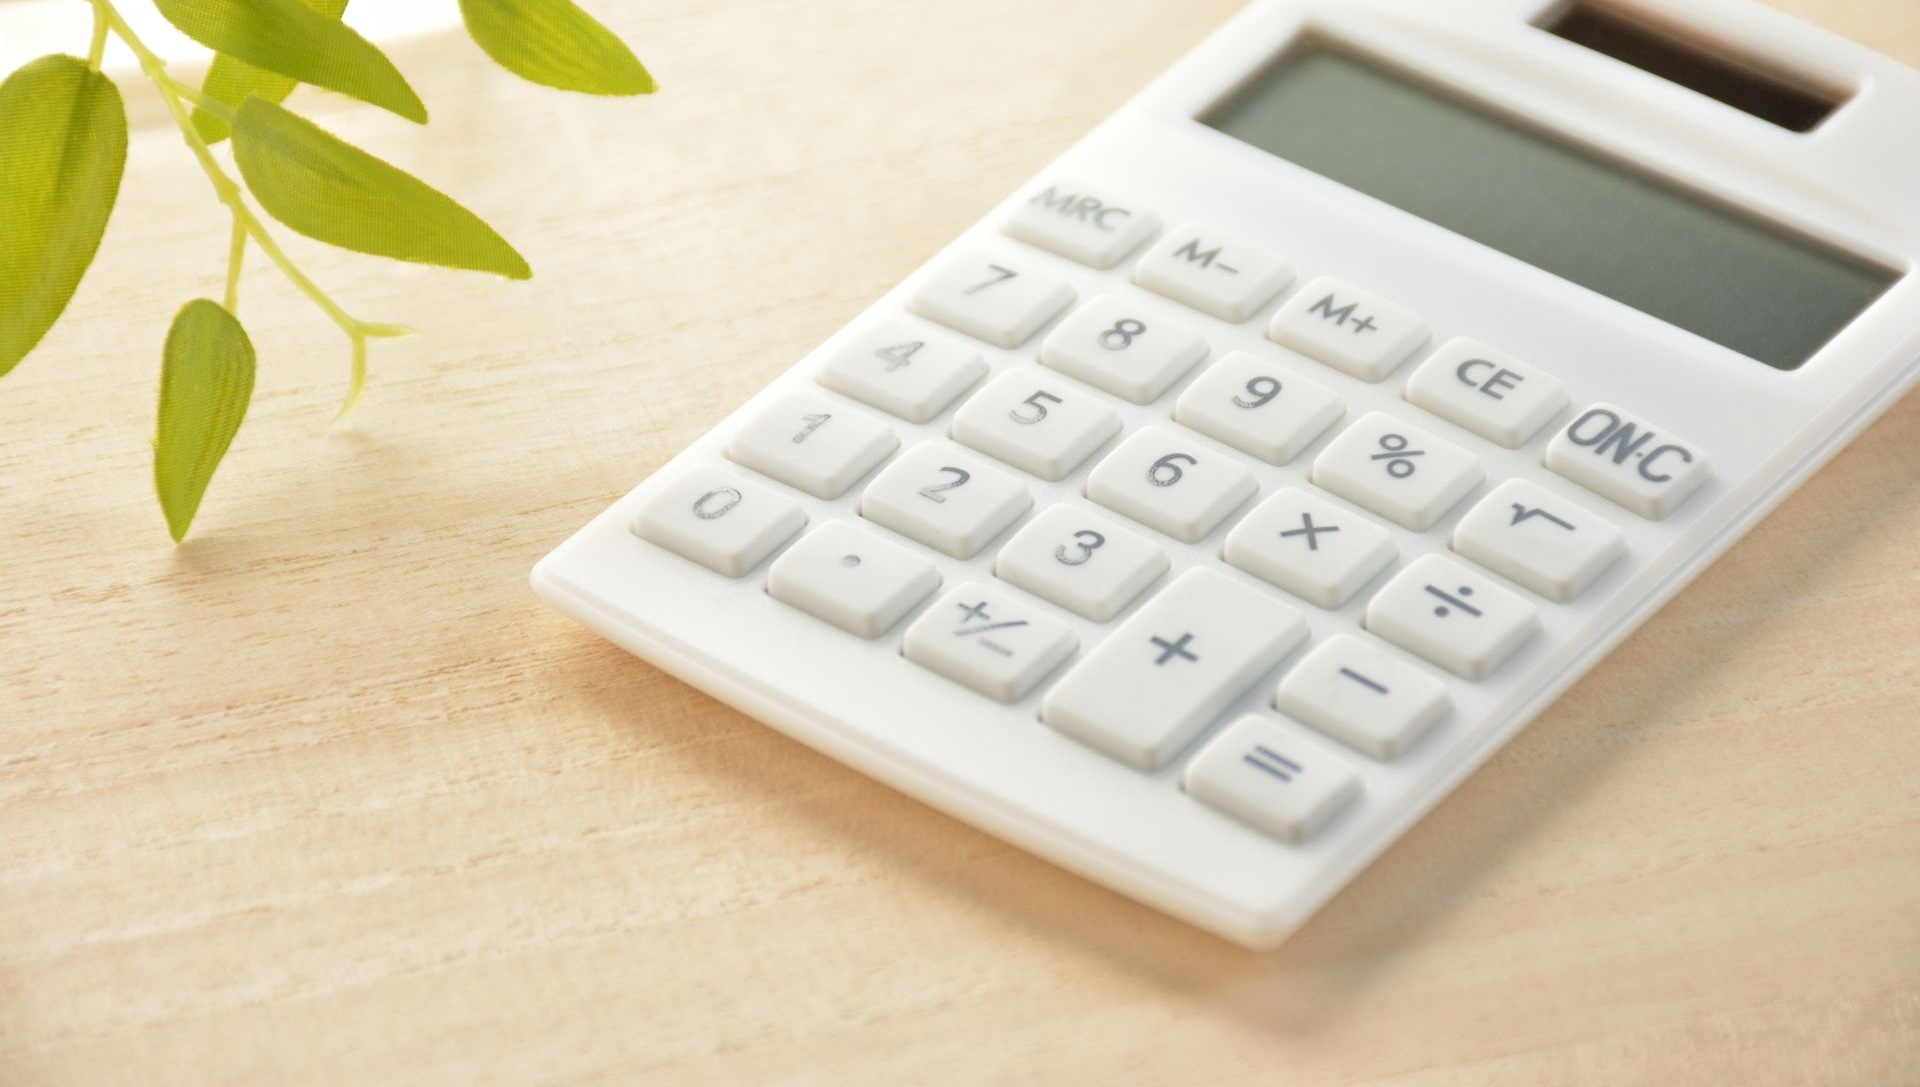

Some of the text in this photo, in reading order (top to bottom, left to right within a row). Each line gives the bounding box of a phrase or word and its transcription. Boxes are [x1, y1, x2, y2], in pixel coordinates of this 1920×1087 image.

[1026, 185, 1132, 232] MRC
[965, 263, 1018, 296] 7
[1306, 292, 1378, 335] M+
[1098, 318, 1147, 351] 8
[873, 340, 926, 373] 4
[1231, 375, 1283, 409] 9
[1455, 358, 1525, 400] CE
[1008, 389, 1064, 426] 5
[791, 412, 833, 445] 1
[1146, 452, 1198, 488] 6
[1370, 433, 1426, 479] %
[917, 465, 971, 504] 2
[691, 486, 744, 520] 0
[1054, 529, 1106, 567] 3
